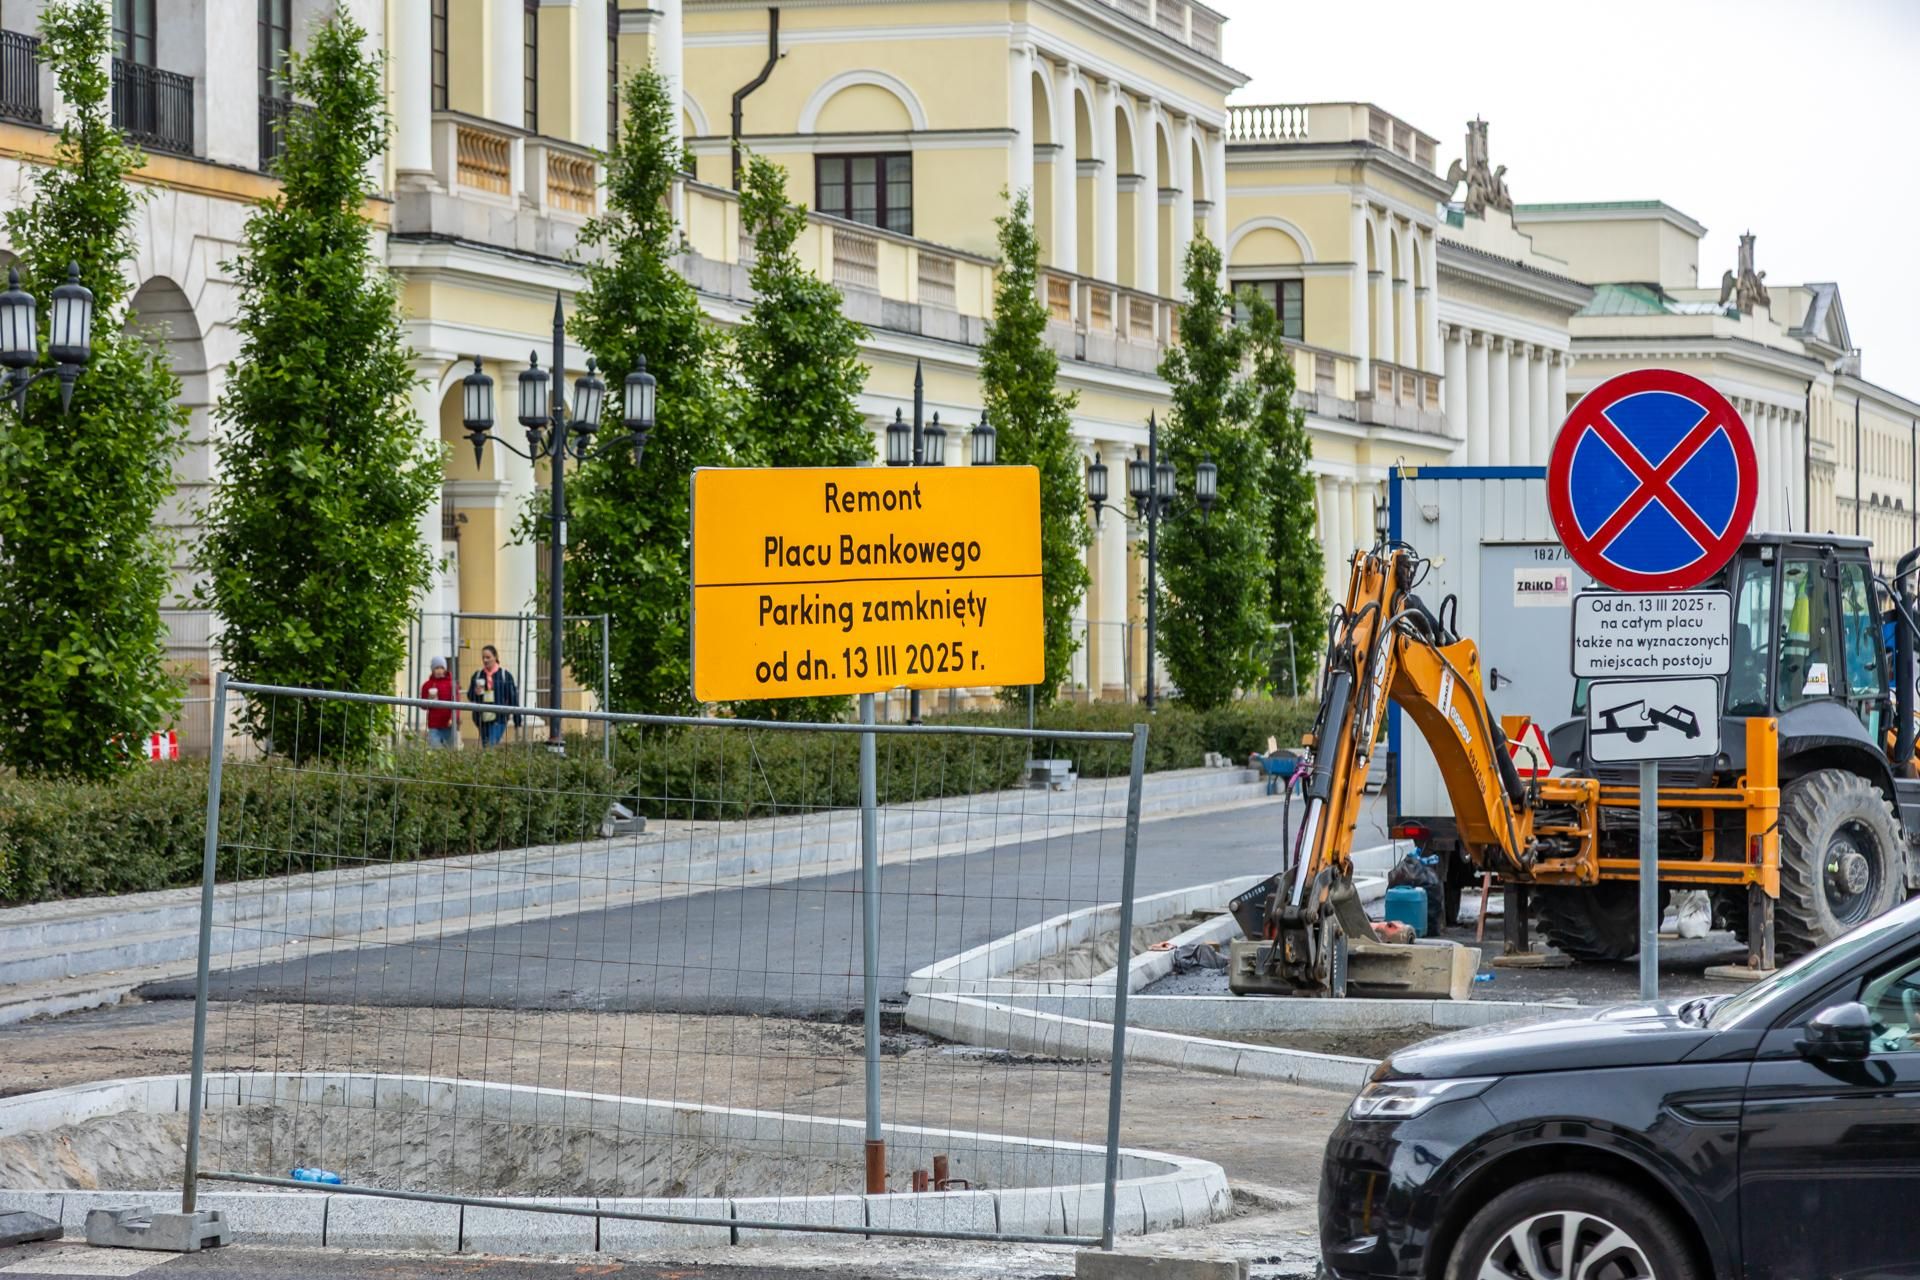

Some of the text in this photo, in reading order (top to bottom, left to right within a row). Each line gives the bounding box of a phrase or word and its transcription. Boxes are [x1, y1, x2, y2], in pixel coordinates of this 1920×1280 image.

[825, 481, 922, 513] Remont
[764, 533, 982, 572] Placu Bankowego
[759, 588, 987, 633] Parking zamknięty
[1591, 598, 1716, 613] Od dn. 13 III 2025 r.
[1601, 615, 1703, 632] na całym placu
[1576, 633, 1729, 651] także na wyznaczonych
[755, 641, 986, 684] od dn. 13 III 2025 r.
[1590, 653, 1712, 672] miejscach postoju
